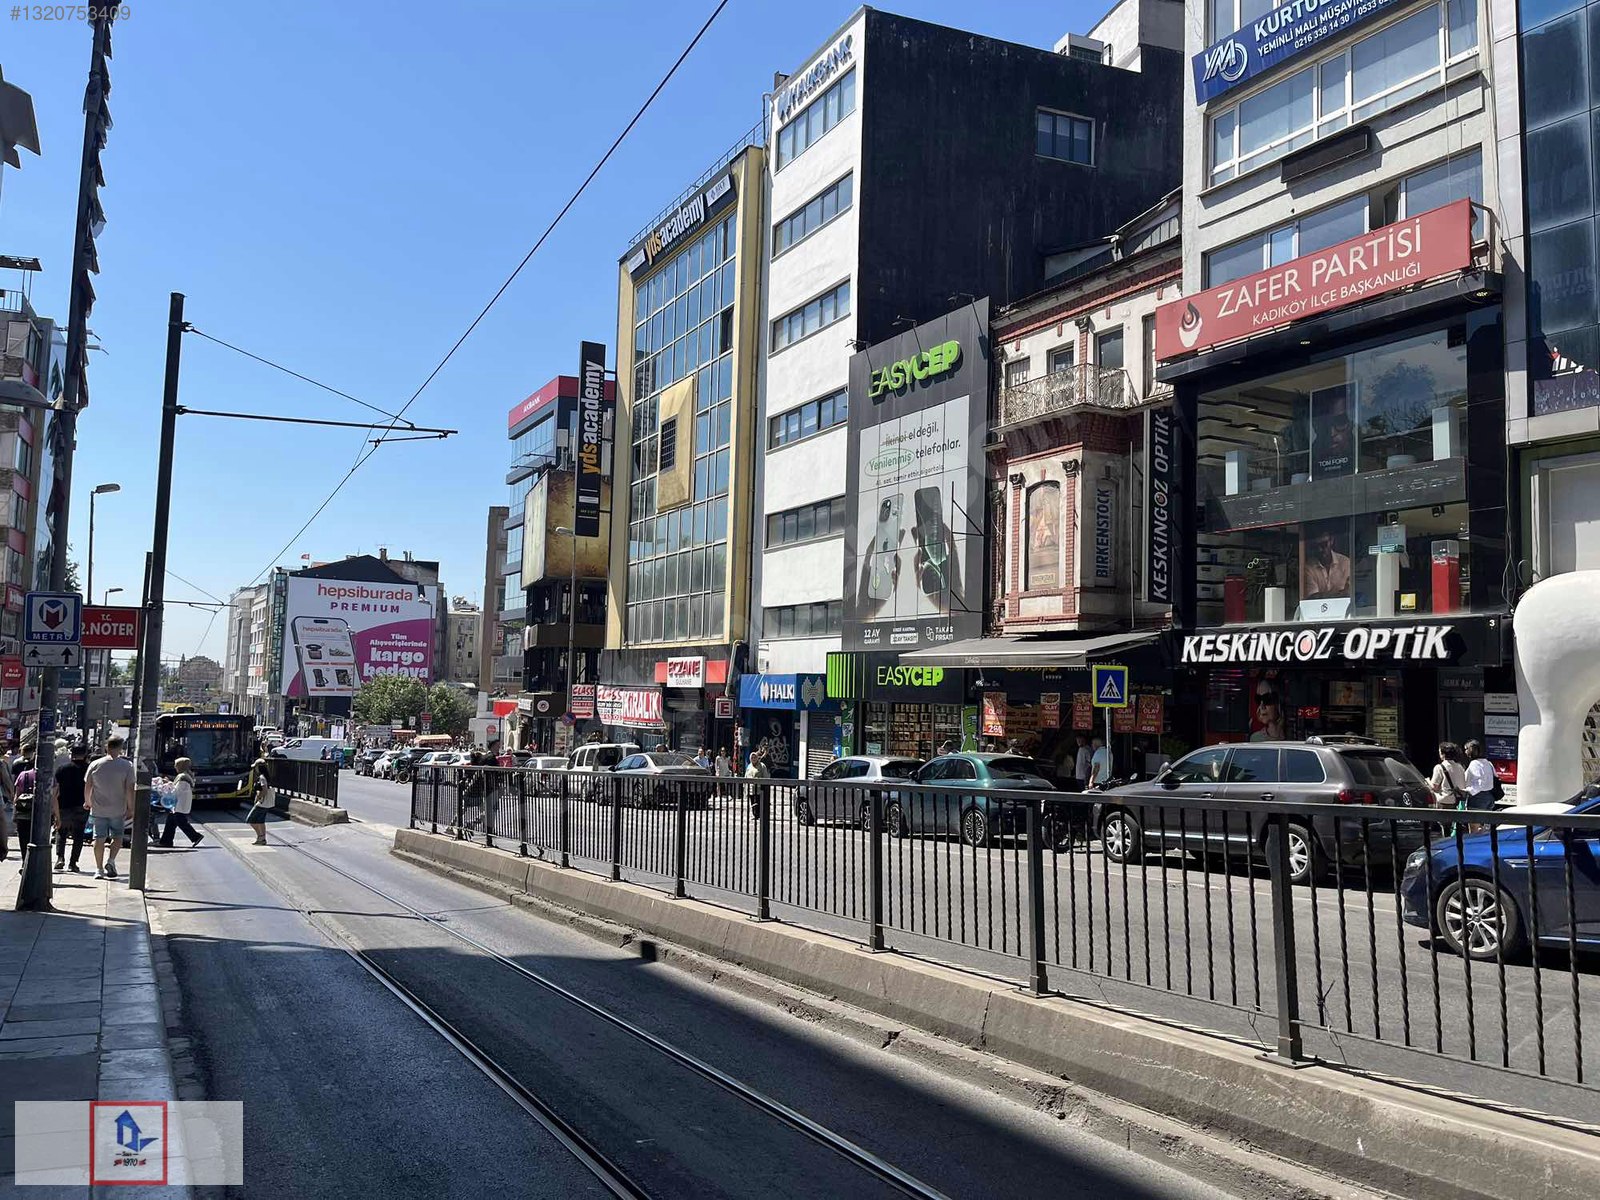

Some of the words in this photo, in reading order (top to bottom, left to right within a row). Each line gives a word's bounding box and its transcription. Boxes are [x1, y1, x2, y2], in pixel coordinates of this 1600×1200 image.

[1294, 33, 1313, 49] 0216
[1314, 25, 1328, 39] 338
[1329, 20, 1339, 30] 14
[1340, 14, 1350, 25] 30
[1357, 0, 1377, 15] 0533
[1257, 28, 1294, 57] YEMİNLİ
[1295, 16, 1318, 37] MALİ
[644, 193, 706, 266] ydsacademy
[1216, 267, 1302, 320] ZAFER
[1310, 217, 1422, 288] PARTİSİ
[1252, 299, 1308, 327] KADIKÖY
[1310, 287, 1338, 310] İLÇE
[1340, 260, 1422, 301] BAŞKANLIĞI
[868, 339, 961, 399] EASYCEP
[579, 361, 604, 474] ydsacademy
[908, 428, 916, 440] el
[1096, 488, 1111, 578] BIRKENSTOCK
[317, 583, 413, 601] hepsiburada
[330, 601, 400, 613] PREMIUM
[864, 629, 871, 638] 12
[871, 628, 880, 638] AY
[935, 626, 954, 634] TAKAS
[1489, 619, 1496, 627] 3
[370, 647, 425, 665] kargo
[363, 662, 429, 678] bedava
[877, 667, 944, 687] EASYCEP
